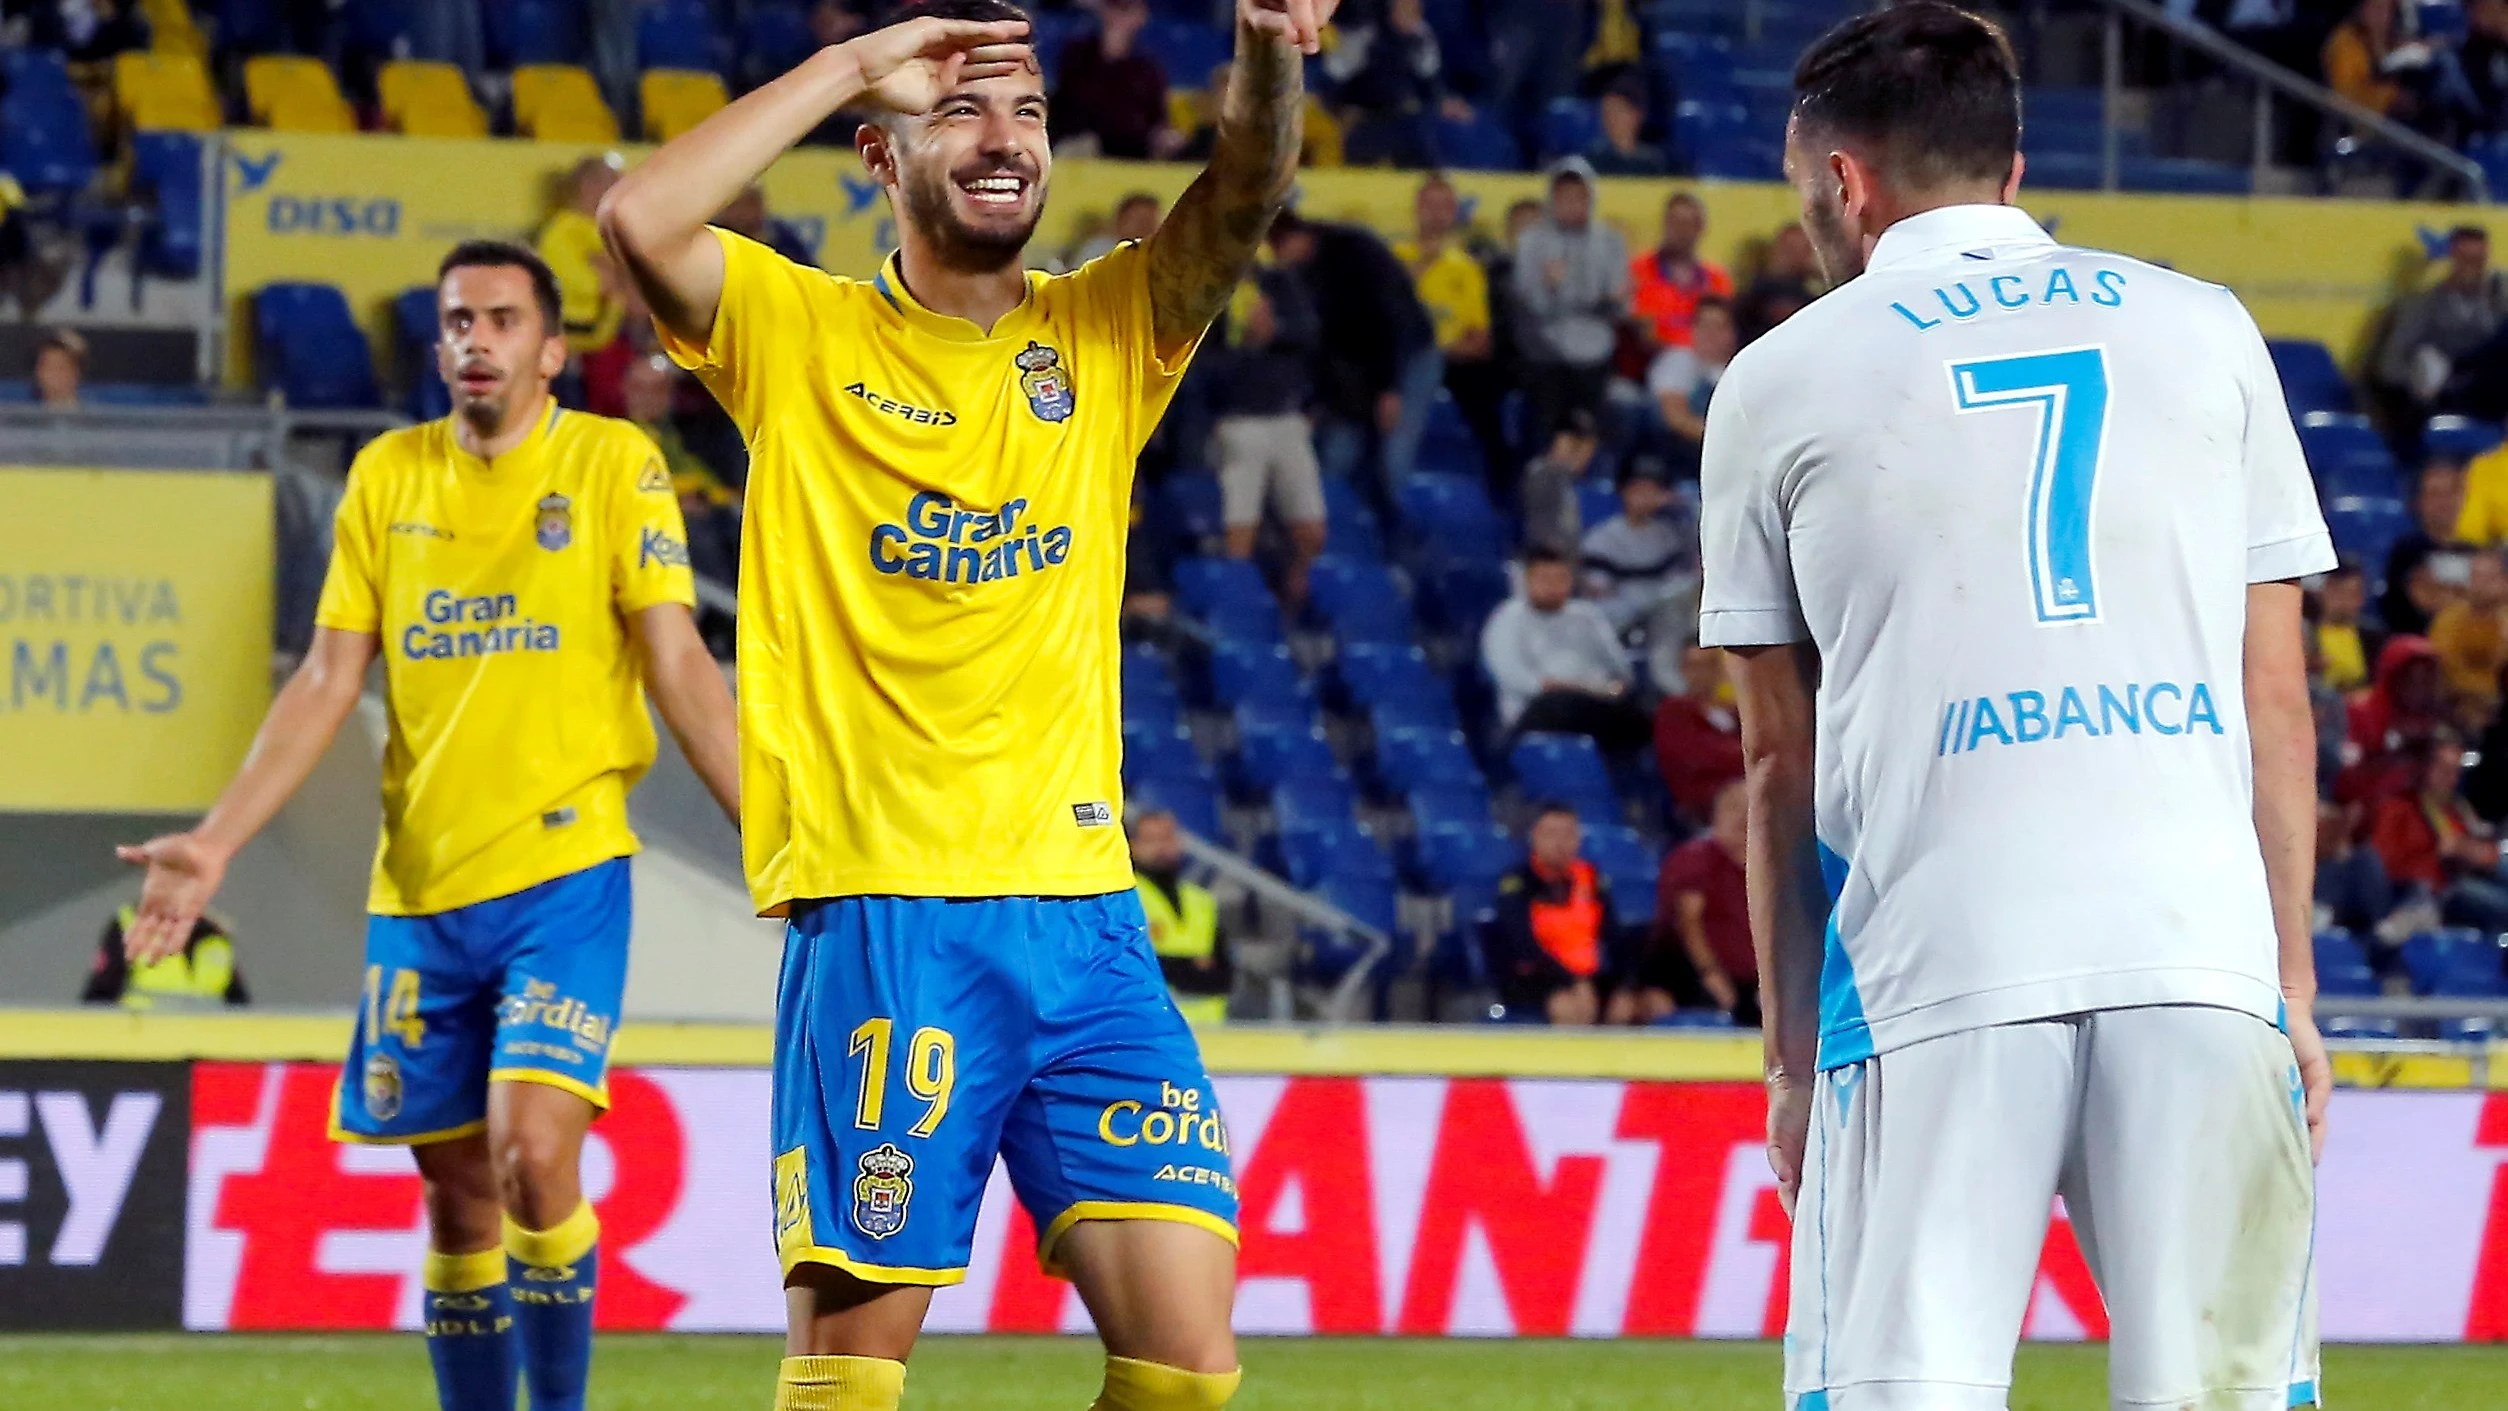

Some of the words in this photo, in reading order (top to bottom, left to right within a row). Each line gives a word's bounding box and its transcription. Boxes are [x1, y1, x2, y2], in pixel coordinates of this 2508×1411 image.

[1890, 267, 2127, 333] LUCAS
[907, 489, 1028, 542] Gran
[1946, 345, 2113, 626] 7
[869, 522, 1072, 584] Canaria
[424, 589, 516, 623] Gran
[403, 618, 559, 660] Canaria
[0, 638, 183, 716] MAS
[366, 965, 427, 1049] 14
[849, 1017, 956, 1138] 19
[1160, 1080, 1200, 1112] be
